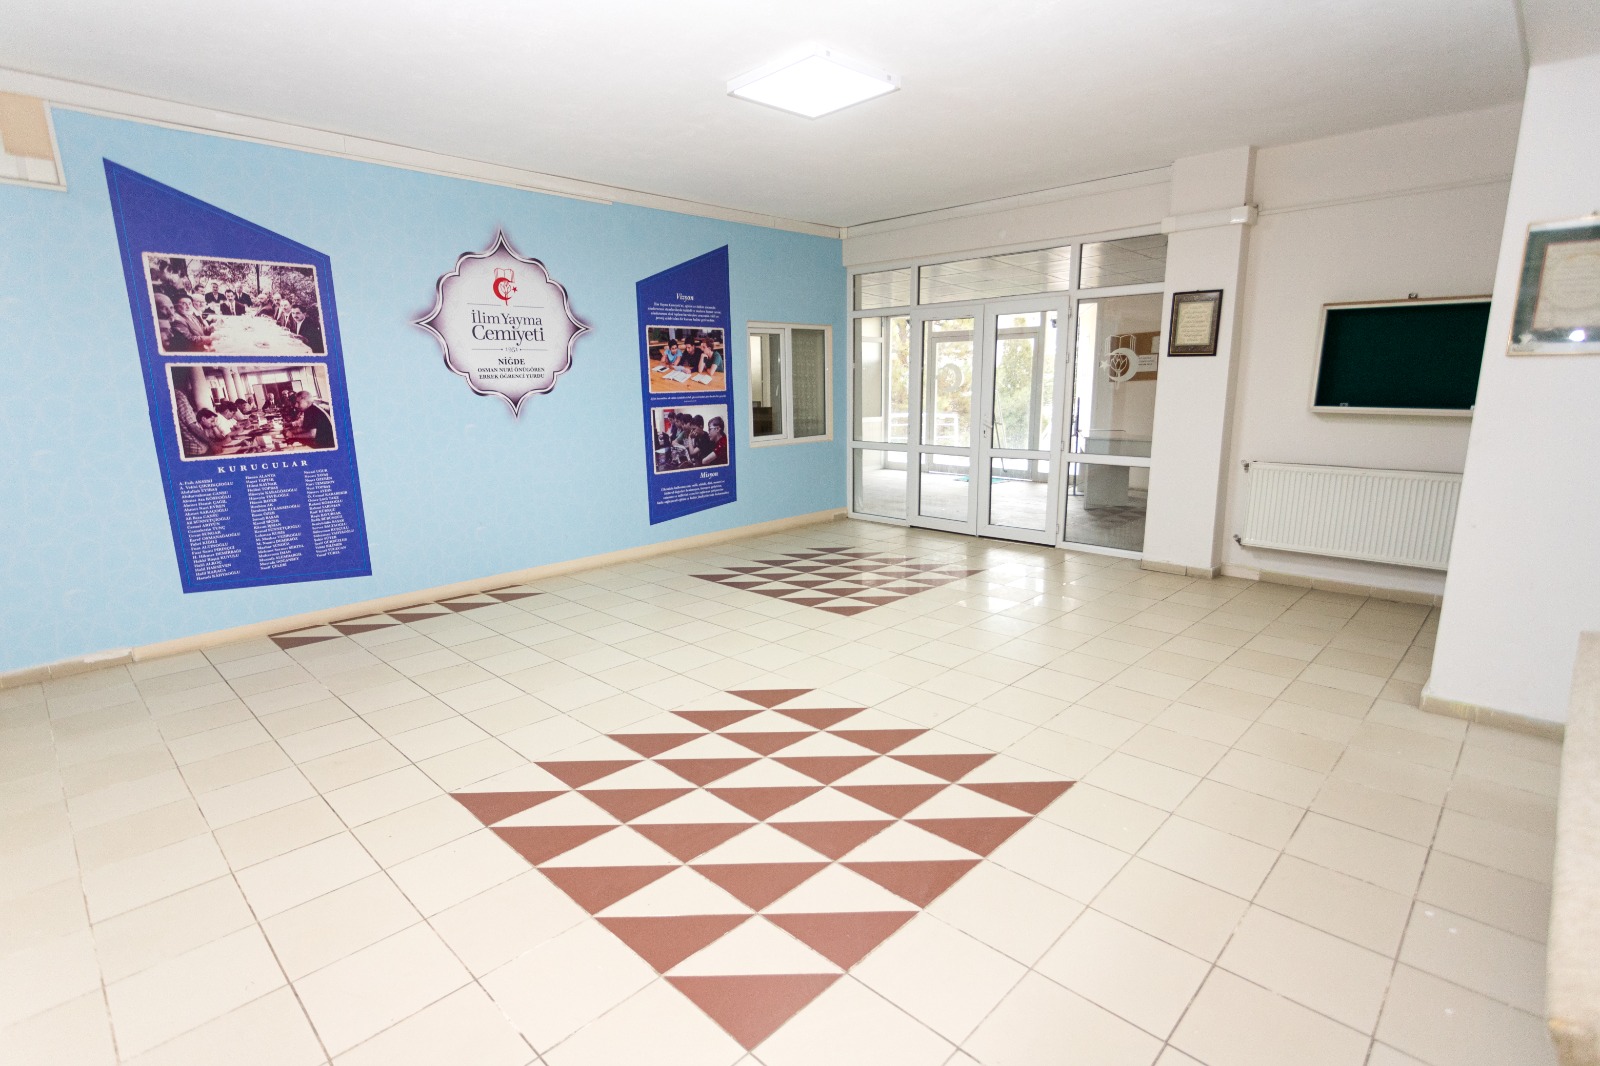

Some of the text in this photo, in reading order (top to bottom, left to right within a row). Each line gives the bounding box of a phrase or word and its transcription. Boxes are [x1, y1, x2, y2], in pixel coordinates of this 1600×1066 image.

[676, 293, 694, 302] Vizyon
[471, 310, 542, 329] İlim Yayma
[472, 325, 545, 346] Cemiyeti
[498, 357, 525, 365] NİĞDE
[217, 460, 308, 473] KURUCULAR
